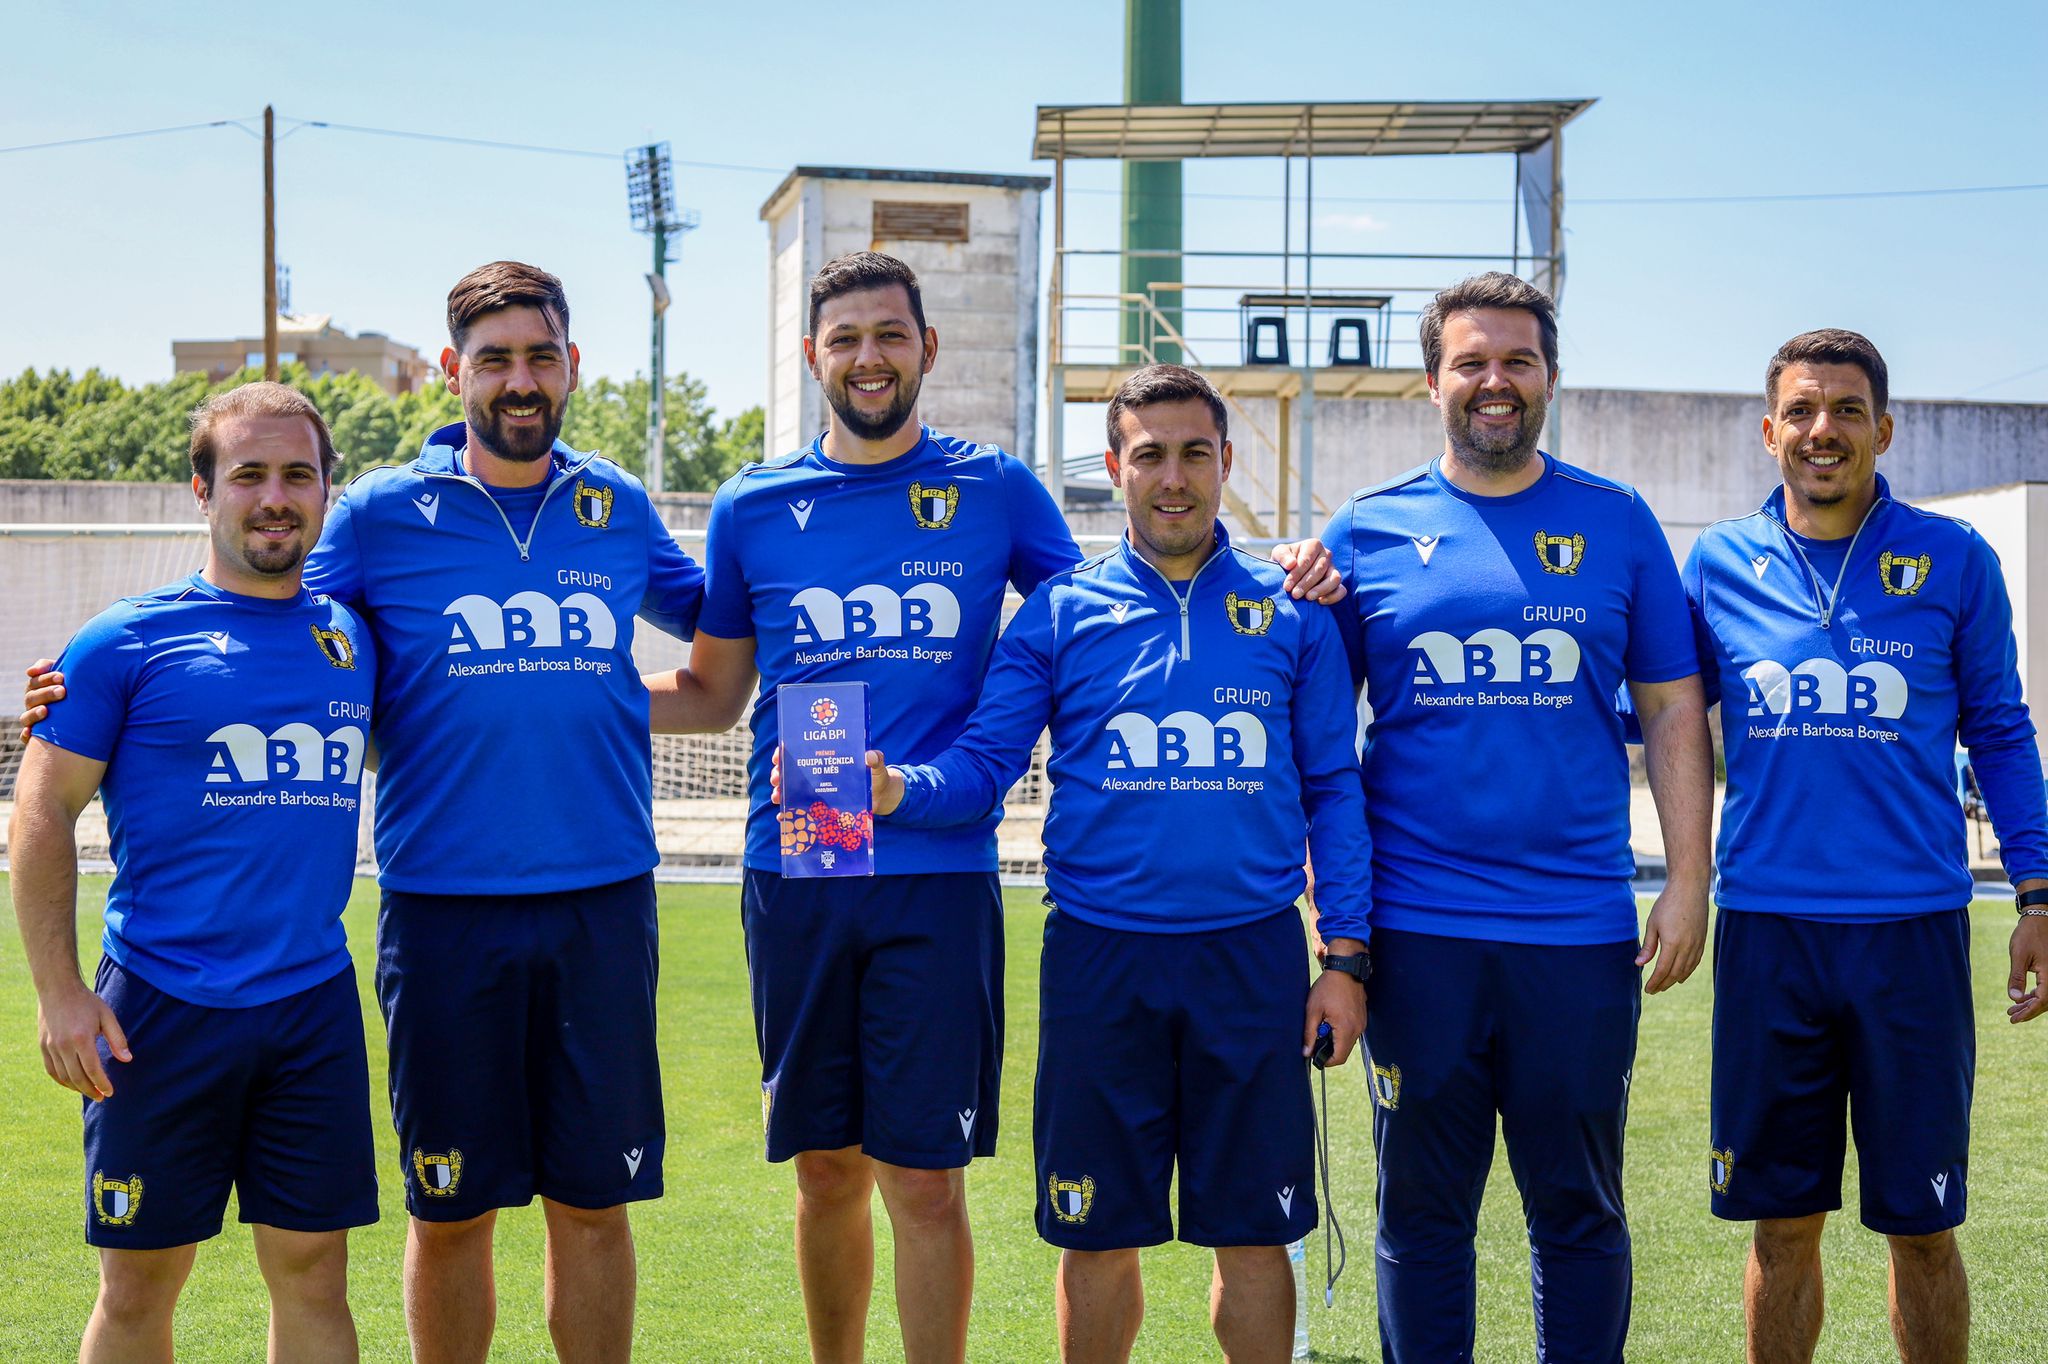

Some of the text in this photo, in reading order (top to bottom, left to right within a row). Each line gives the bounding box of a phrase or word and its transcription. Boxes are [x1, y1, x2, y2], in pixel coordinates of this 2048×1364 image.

[557, 569, 612, 591] GRUPO
[901, 561, 963, 577] GRUPO
[442, 590, 617, 655] ABB
[789, 582, 961, 644] ABB
[1523, 606, 1587, 623] GRUPO
[795, 645, 953, 665] Alexandre Barbosa Borges
[1407, 628, 1581, 685] ABB
[1850, 637, 1914, 659] GRUPO
[448, 656, 612, 678] Alexandre Barbosa Borges
[1214, 687, 1271, 707] GRUPO
[1745, 657, 1909, 720] ABB
[1414, 691, 1573, 709] Alexandre Barbosa Borges
[328, 701, 371, 722] GRUPO
[803, 729, 846, 741] LIGA BPI
[1105, 710, 1268, 769] ABB
[1748, 722, 1899, 744] Alexandre Barbosa Borges
[205, 722, 365, 785] ABB
[797, 756, 854, 767] EQUIPA TÉCNICA
[812, 765, 839, 775] DO MÊS
[1102, 777, 1264, 795] Alexandre Barbosa Borges
[202, 790, 357, 812] Alexandre Barbosa Borges
